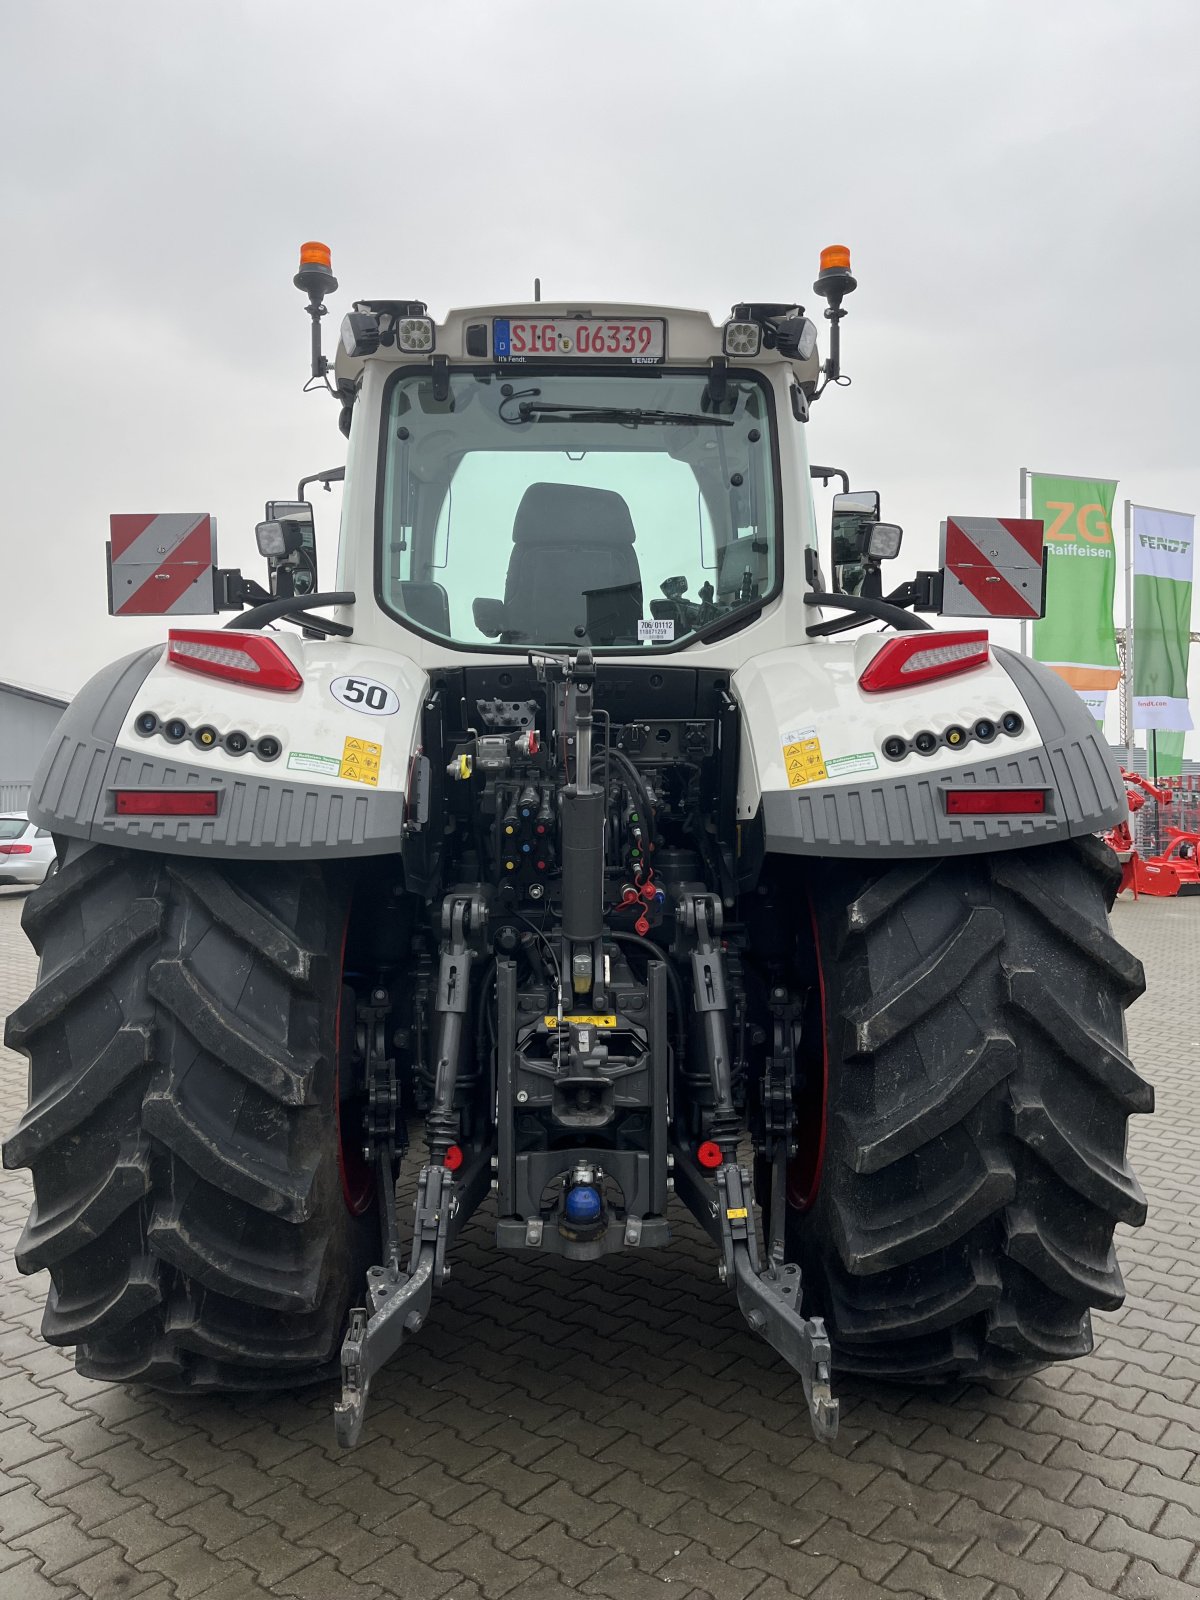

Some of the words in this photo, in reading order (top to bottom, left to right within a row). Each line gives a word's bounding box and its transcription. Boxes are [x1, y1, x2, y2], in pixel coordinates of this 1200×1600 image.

[511, 324, 557, 353] SIG
[575, 325, 652, 354] 06339
[1045, 501, 1112, 544] ZG
[1045, 543, 1112, 559] Raiffeisen
[1138, 534, 1191, 554] FENDT
[343, 678, 388, 710] 50
